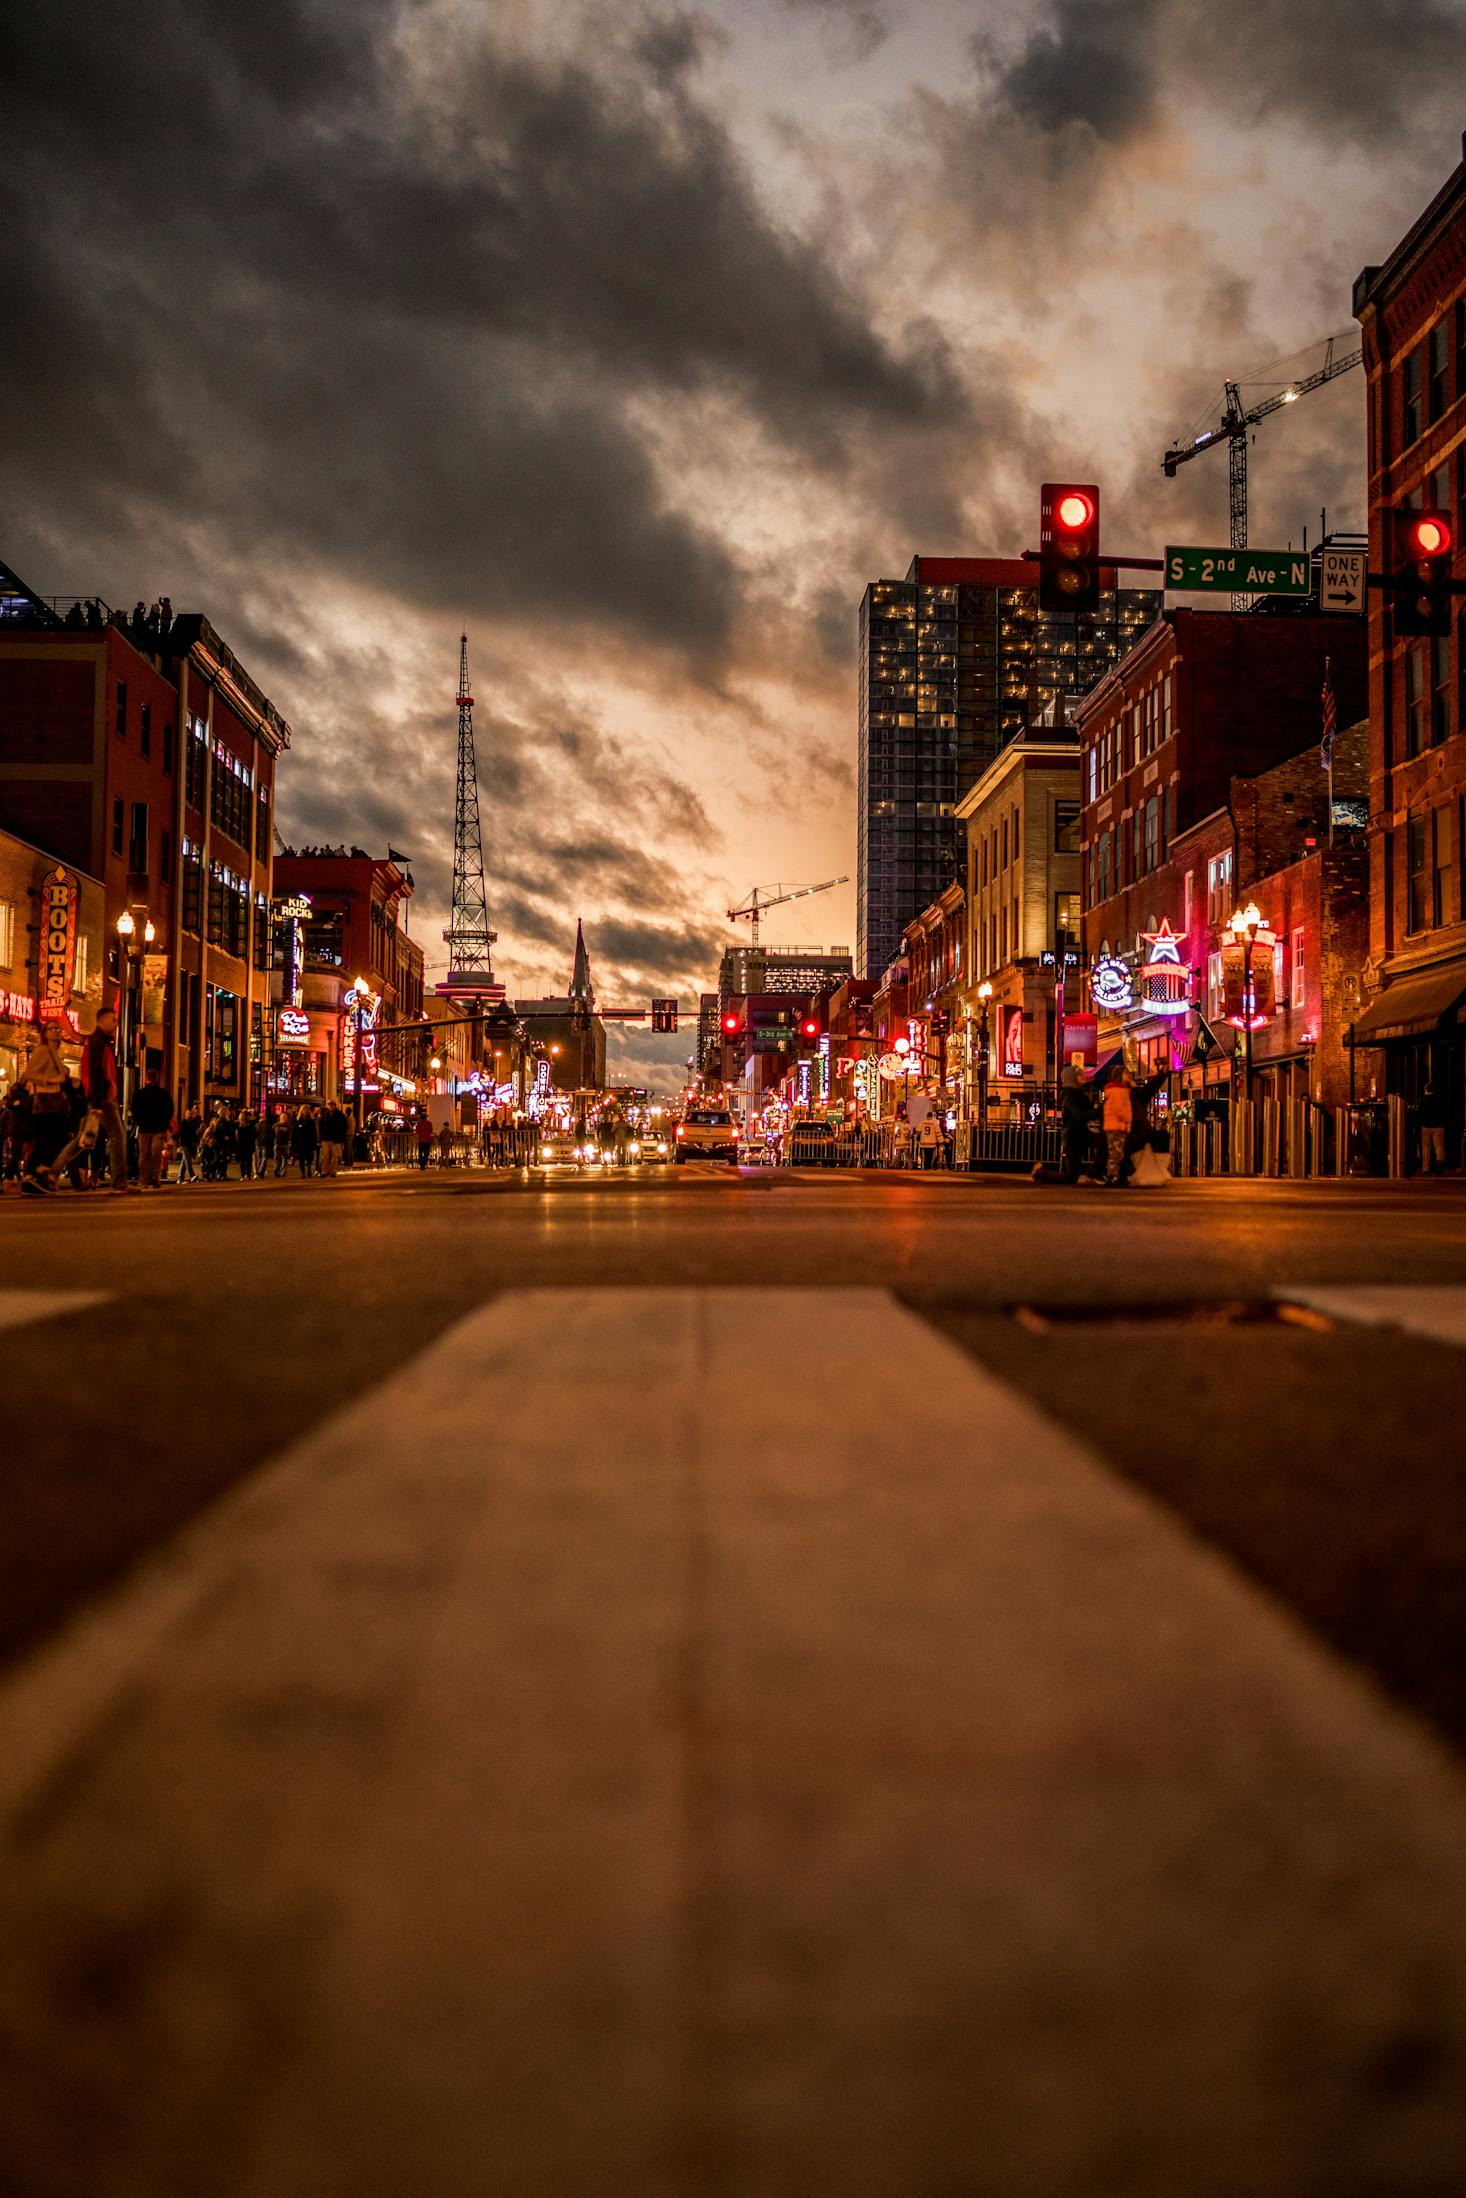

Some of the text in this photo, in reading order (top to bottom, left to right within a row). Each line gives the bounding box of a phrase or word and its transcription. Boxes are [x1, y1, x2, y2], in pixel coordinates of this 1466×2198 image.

[1328, 556, 1360, 571] ONE
[1326, 573, 1360, 588] WAY
[288, 898, 308, 909] KID
[47, 886, 68, 998] BOOTS
[1093, 984, 1132, 1001] COLLECTION
[9, 992, 33, 1021] HATS
[40, 997, 66, 1009] TRAIL
[41, 1008, 64, 1018] WEST
[279, 1034, 309, 1044] STEAKHOUSE
[1005, 1062, 1023, 1070] OLE
[1005, 1068, 1023, 1076] RED
[924, 1126, 931, 1136] 9
